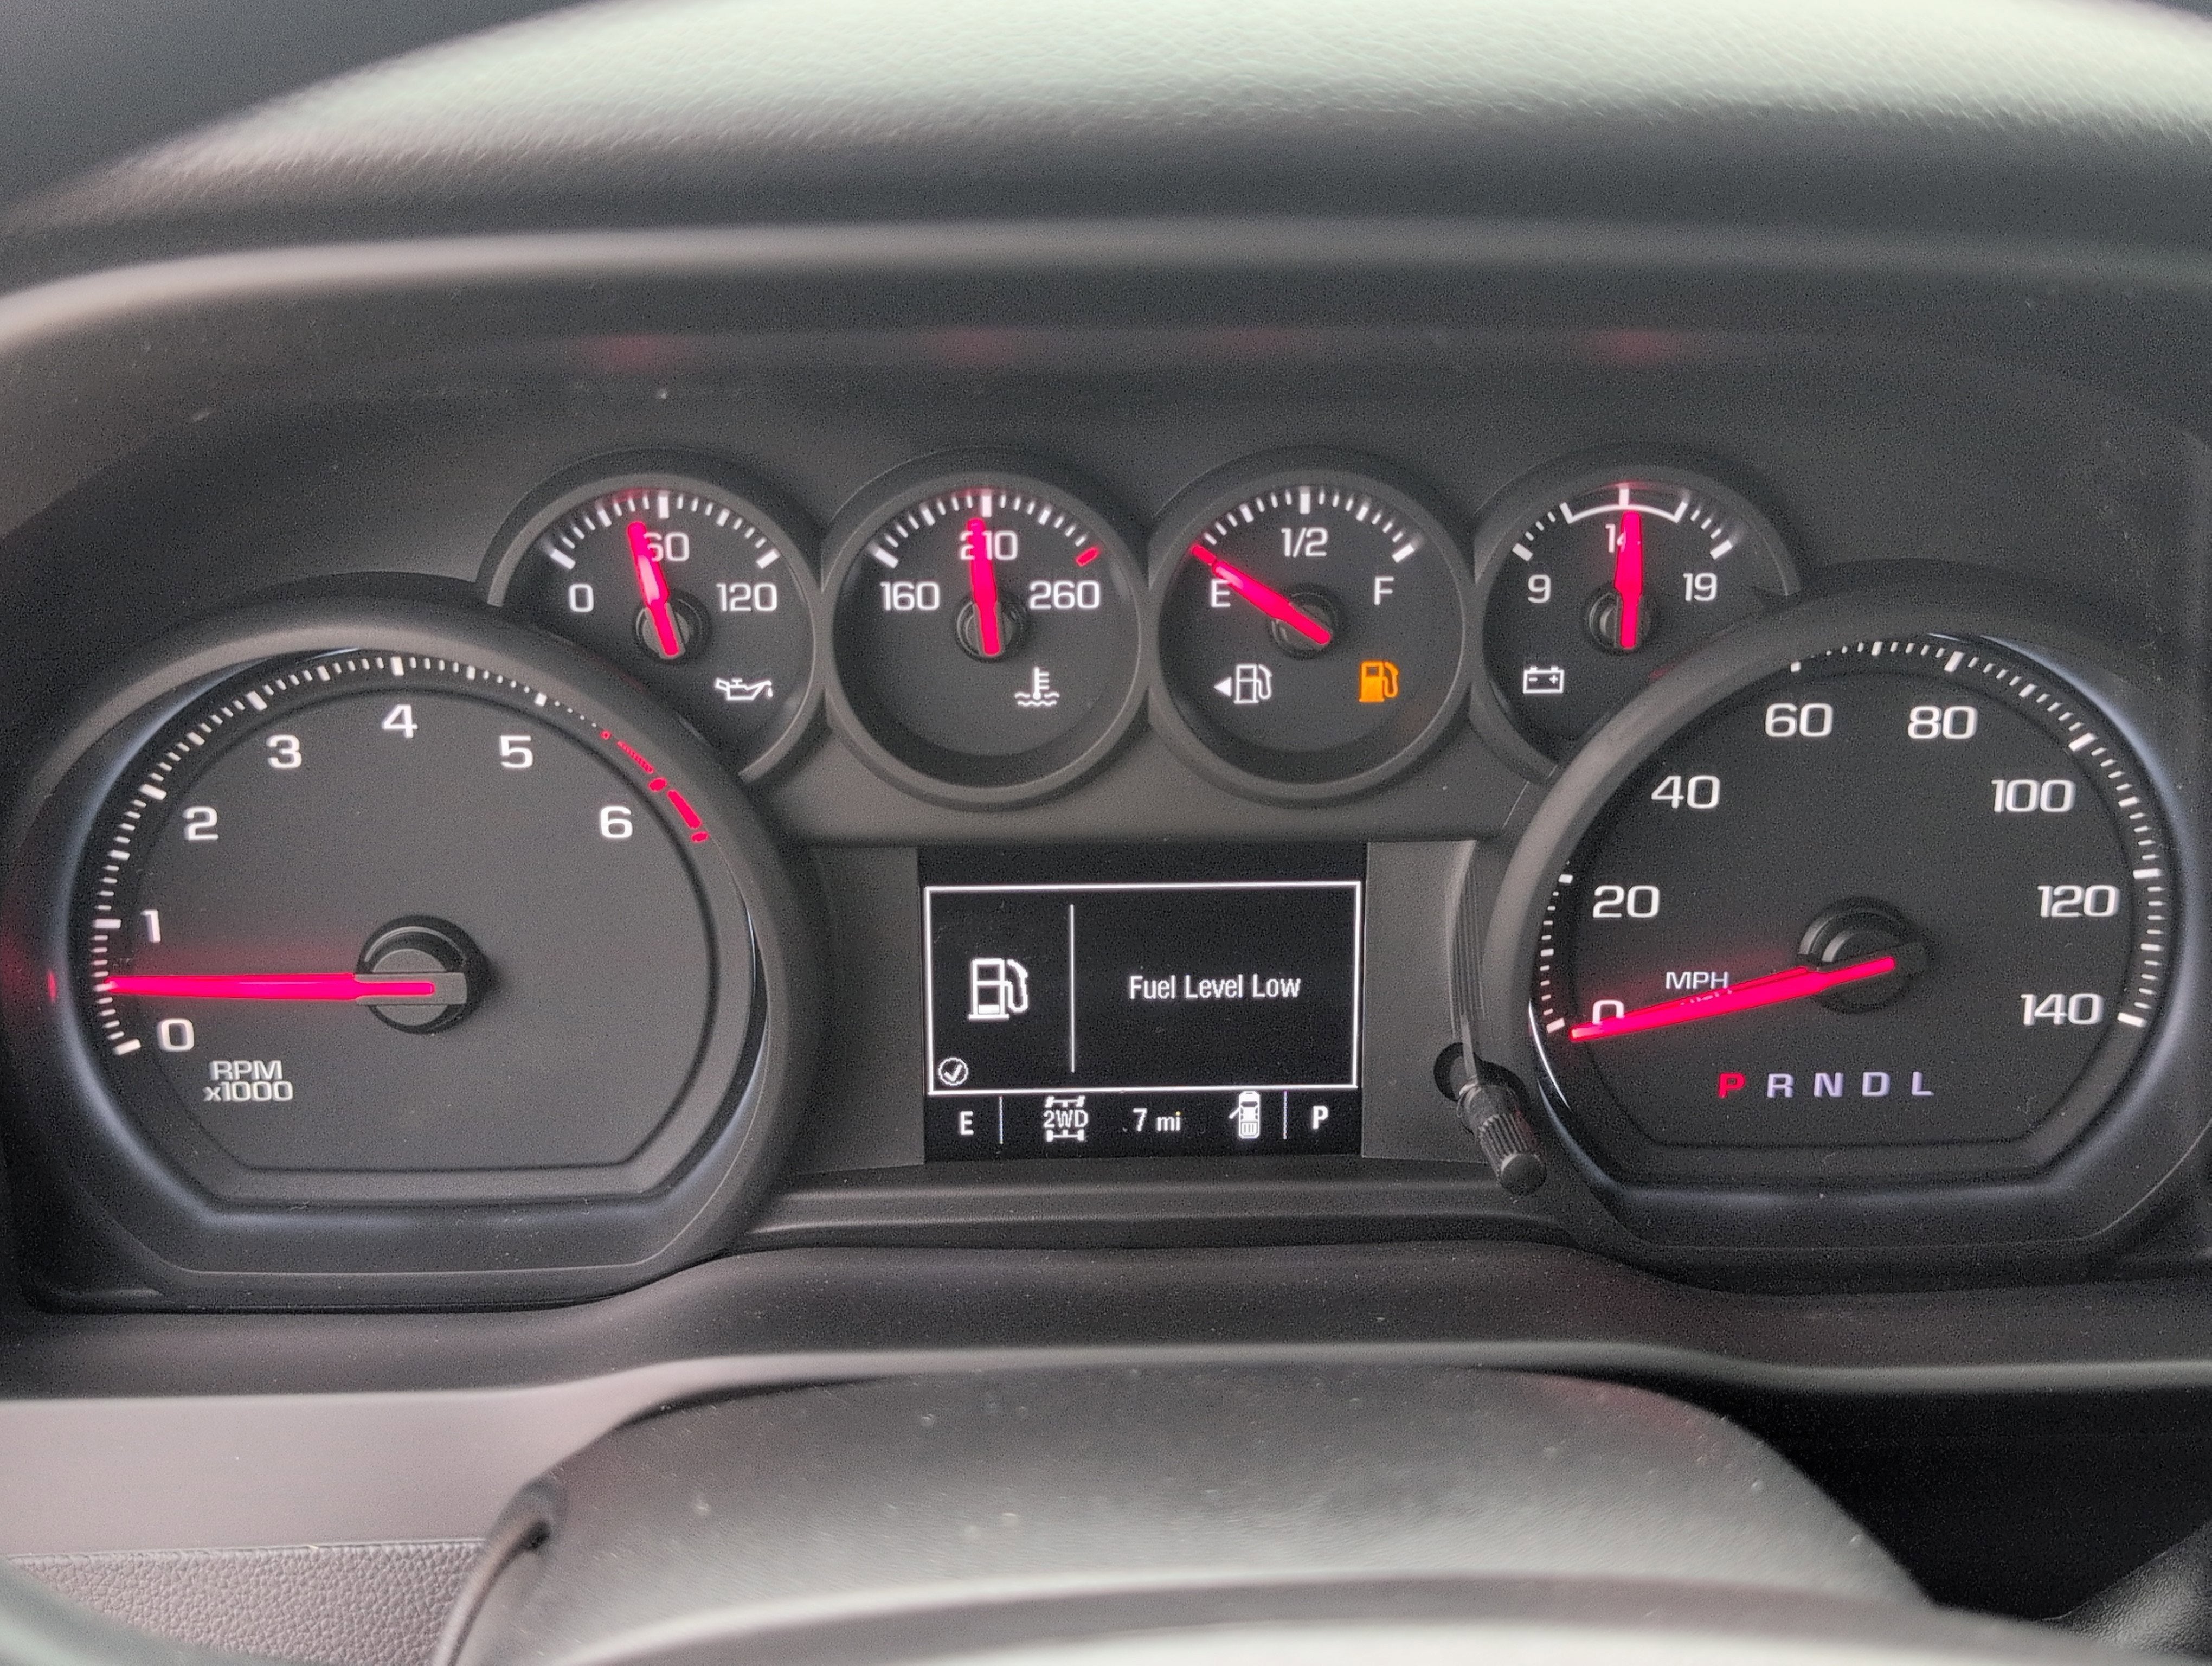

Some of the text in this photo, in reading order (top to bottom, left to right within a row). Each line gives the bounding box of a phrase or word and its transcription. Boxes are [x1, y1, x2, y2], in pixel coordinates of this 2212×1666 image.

[1281, 527, 1328, 558] 1/2
[1605, 523, 1631, 553] 1
[568, 583, 594, 613] 0
[716, 582, 777, 612] 120
[880, 581, 940, 611] 160
[1030, 580, 1100, 610] 260
[1210, 578, 1231, 608] E
[1374, 576, 1394, 605] F
[1527, 574, 1551, 603] 9
[1683, 572, 1718, 601] 19
[382, 704, 418, 738] 4
[1765, 703, 1833, 738] 60
[1907, 706, 1977, 739] 80
[267, 734, 302, 769] 3
[499, 735, 533, 769] 5
[1651, 775, 1721, 809] 40
[1991, 779, 2075, 812] 100
[183, 806, 219, 840] 2
[599, 806, 633, 839] 6
[1592, 885, 1660, 918] 20
[2038, 885, 2120, 918] 120
[140, 909, 161, 943] 1
[1129, 974, 1301, 1000] Fuel Level Low
[1666, 972, 1729, 990] MPH
[2021, 994, 2103, 1026] 140
[157, 1018, 195, 1052] 0
[210, 1060, 283, 1080] RPM
[1718, 1071, 1934, 1099] P R N D L
[202, 1081, 293, 1102] x1000
[959, 1111, 974, 1136] E
[1044, 1111, 1088, 1129] 2WD
[1133, 1110, 1181, 1131] 7 mi
[1313, 1106, 1329, 1130] P
